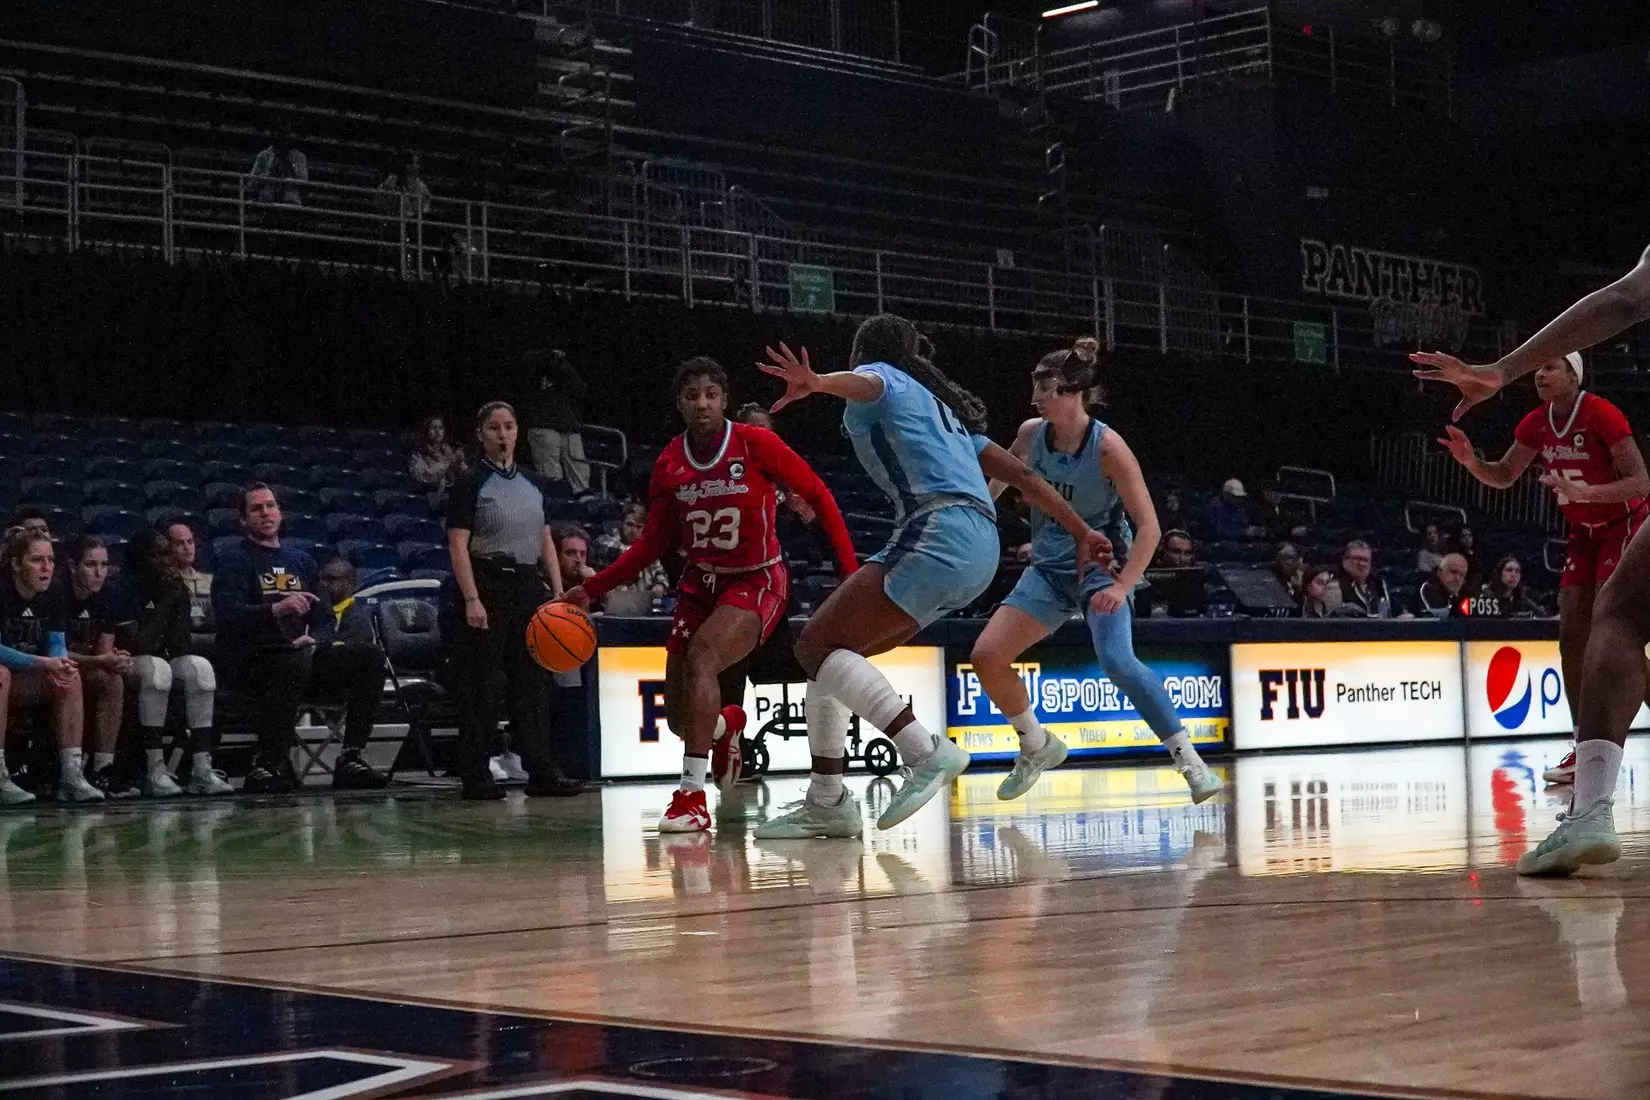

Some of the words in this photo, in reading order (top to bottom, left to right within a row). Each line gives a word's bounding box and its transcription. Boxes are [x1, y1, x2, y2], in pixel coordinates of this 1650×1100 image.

[1300, 239, 1486, 318] PANTHER
[686, 506, 741, 550] 23
[1258, 668, 1326, 721] FIU
[1336, 682, 1396, 703] Panther
[1399, 680, 1442, 700] TECH
